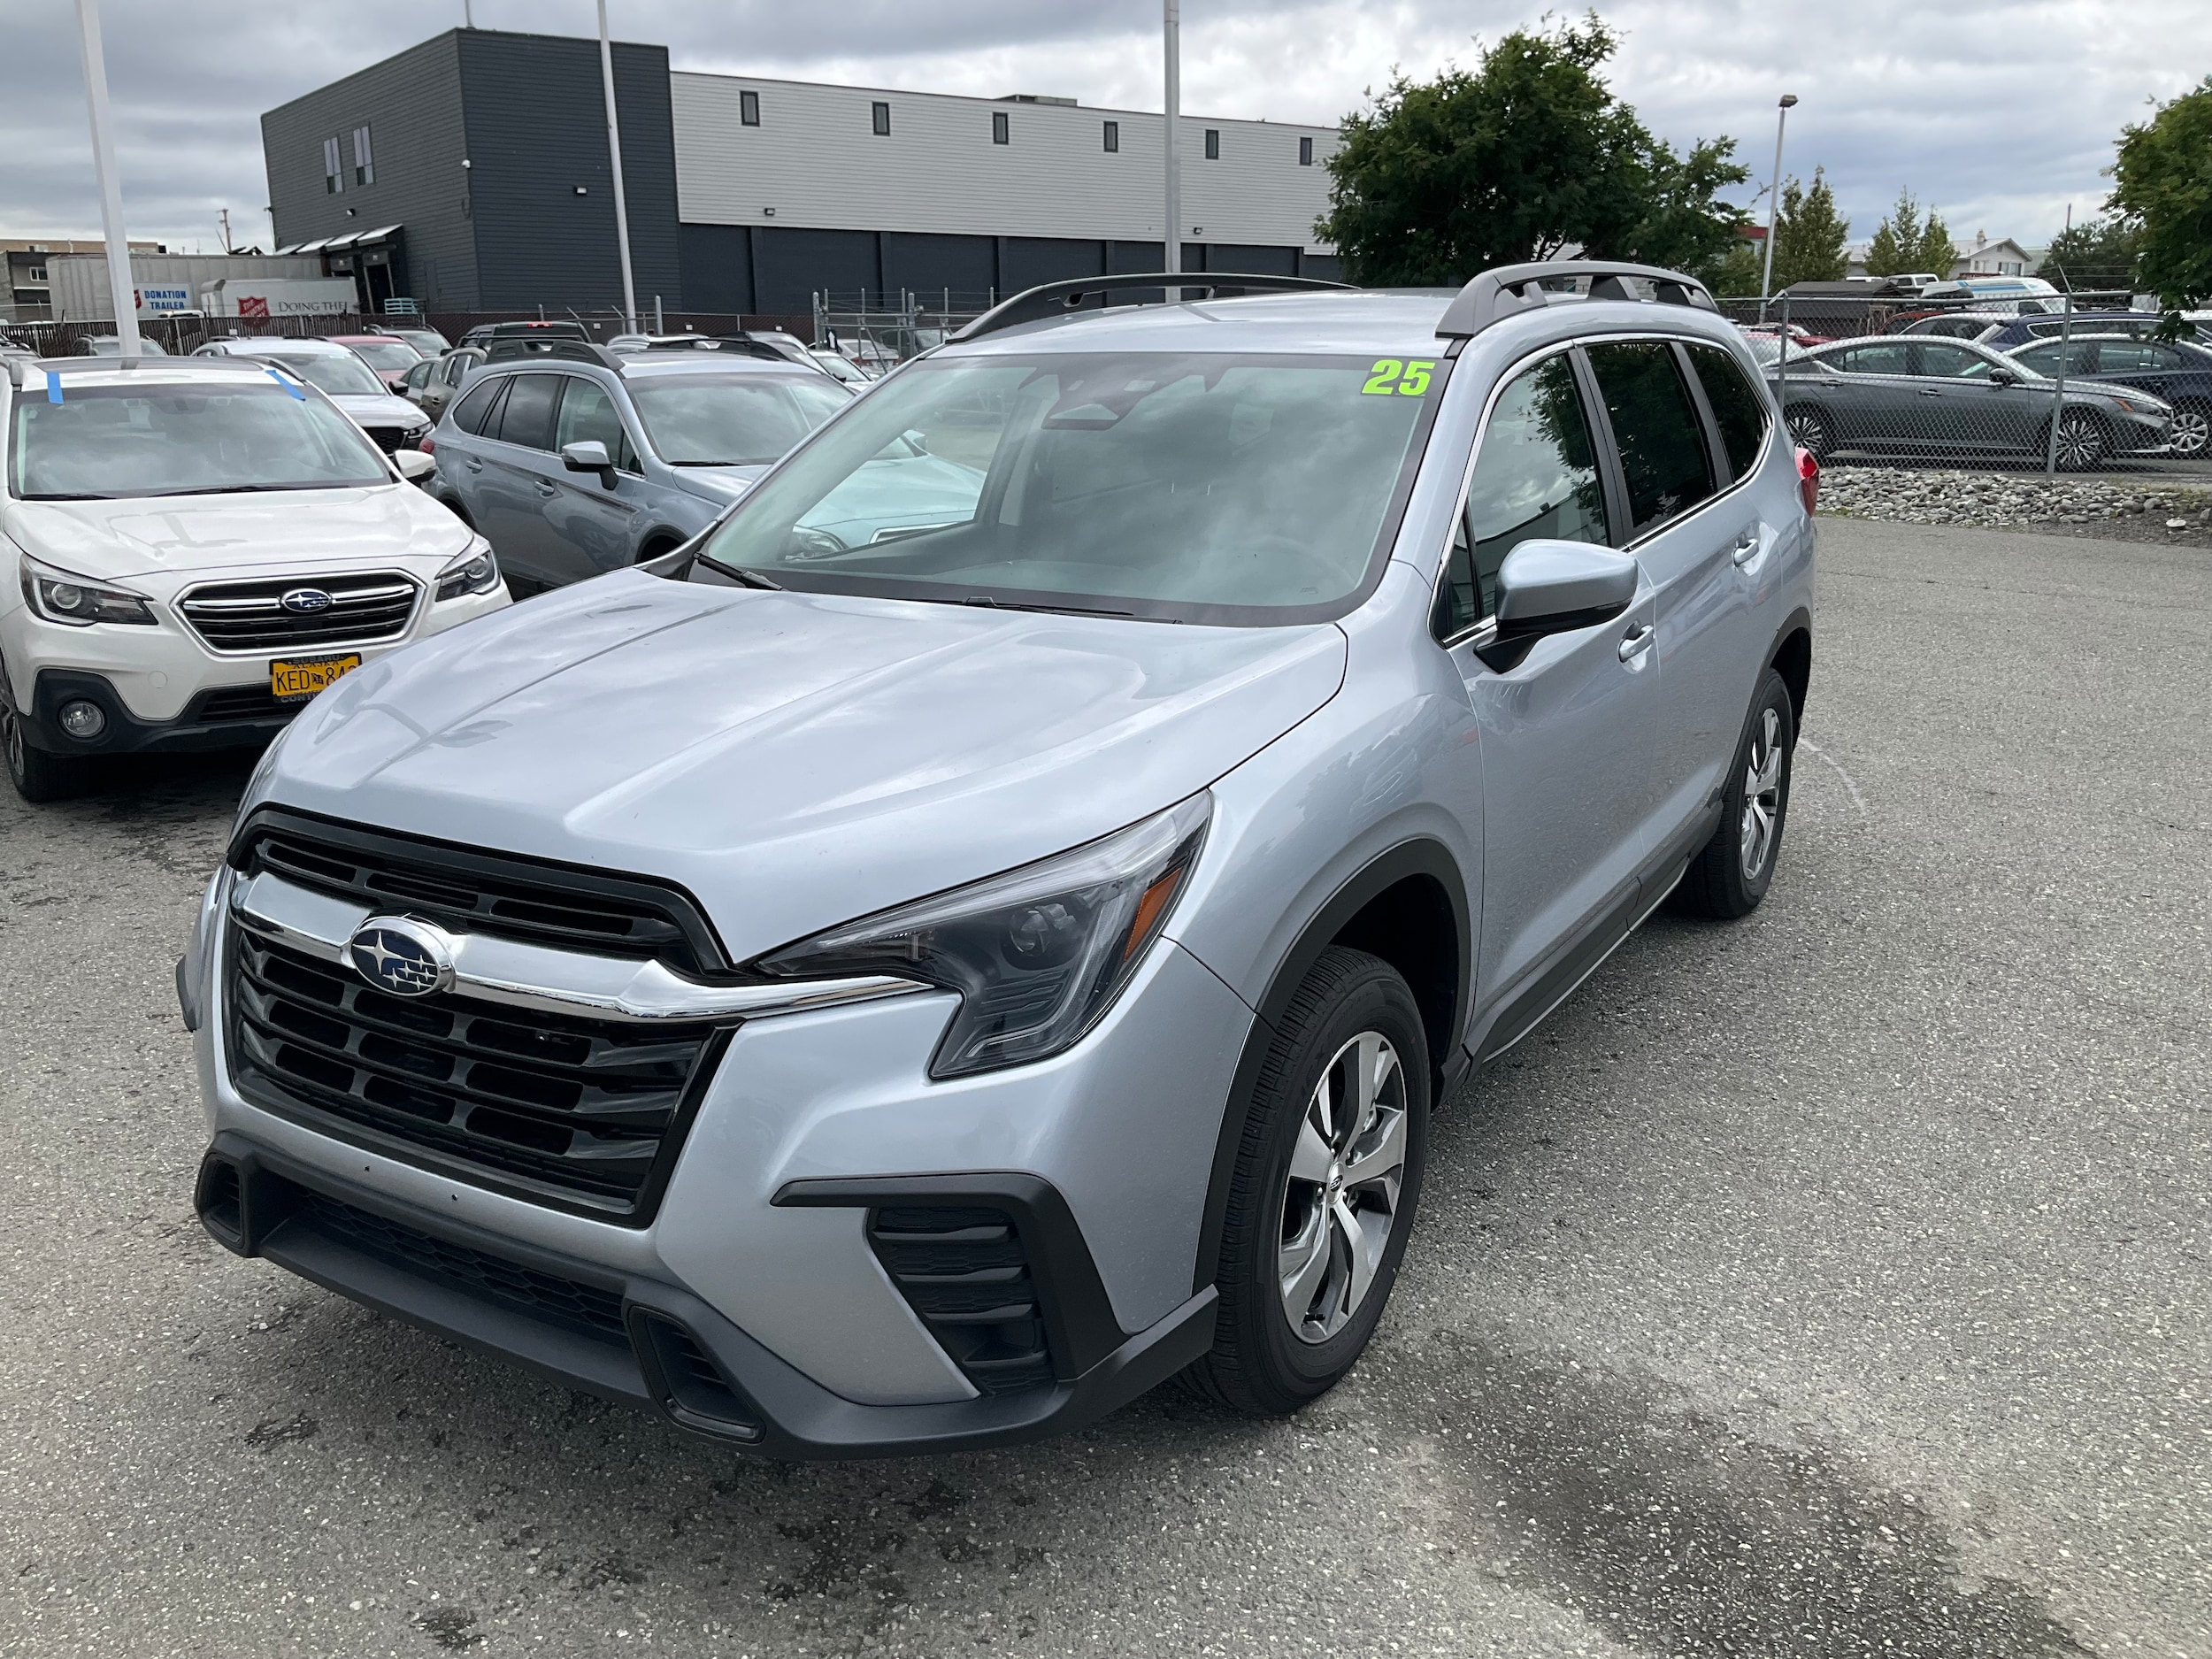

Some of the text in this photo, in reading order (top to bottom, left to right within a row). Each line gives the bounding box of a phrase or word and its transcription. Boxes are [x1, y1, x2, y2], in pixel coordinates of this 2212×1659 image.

[144, 290, 187, 299] DONATION
[279, 302, 319, 311] DOING
[1362, 359, 1435, 396] 25
[293, 655, 340, 664] SUBARU
[275, 670, 311, 692] KED
